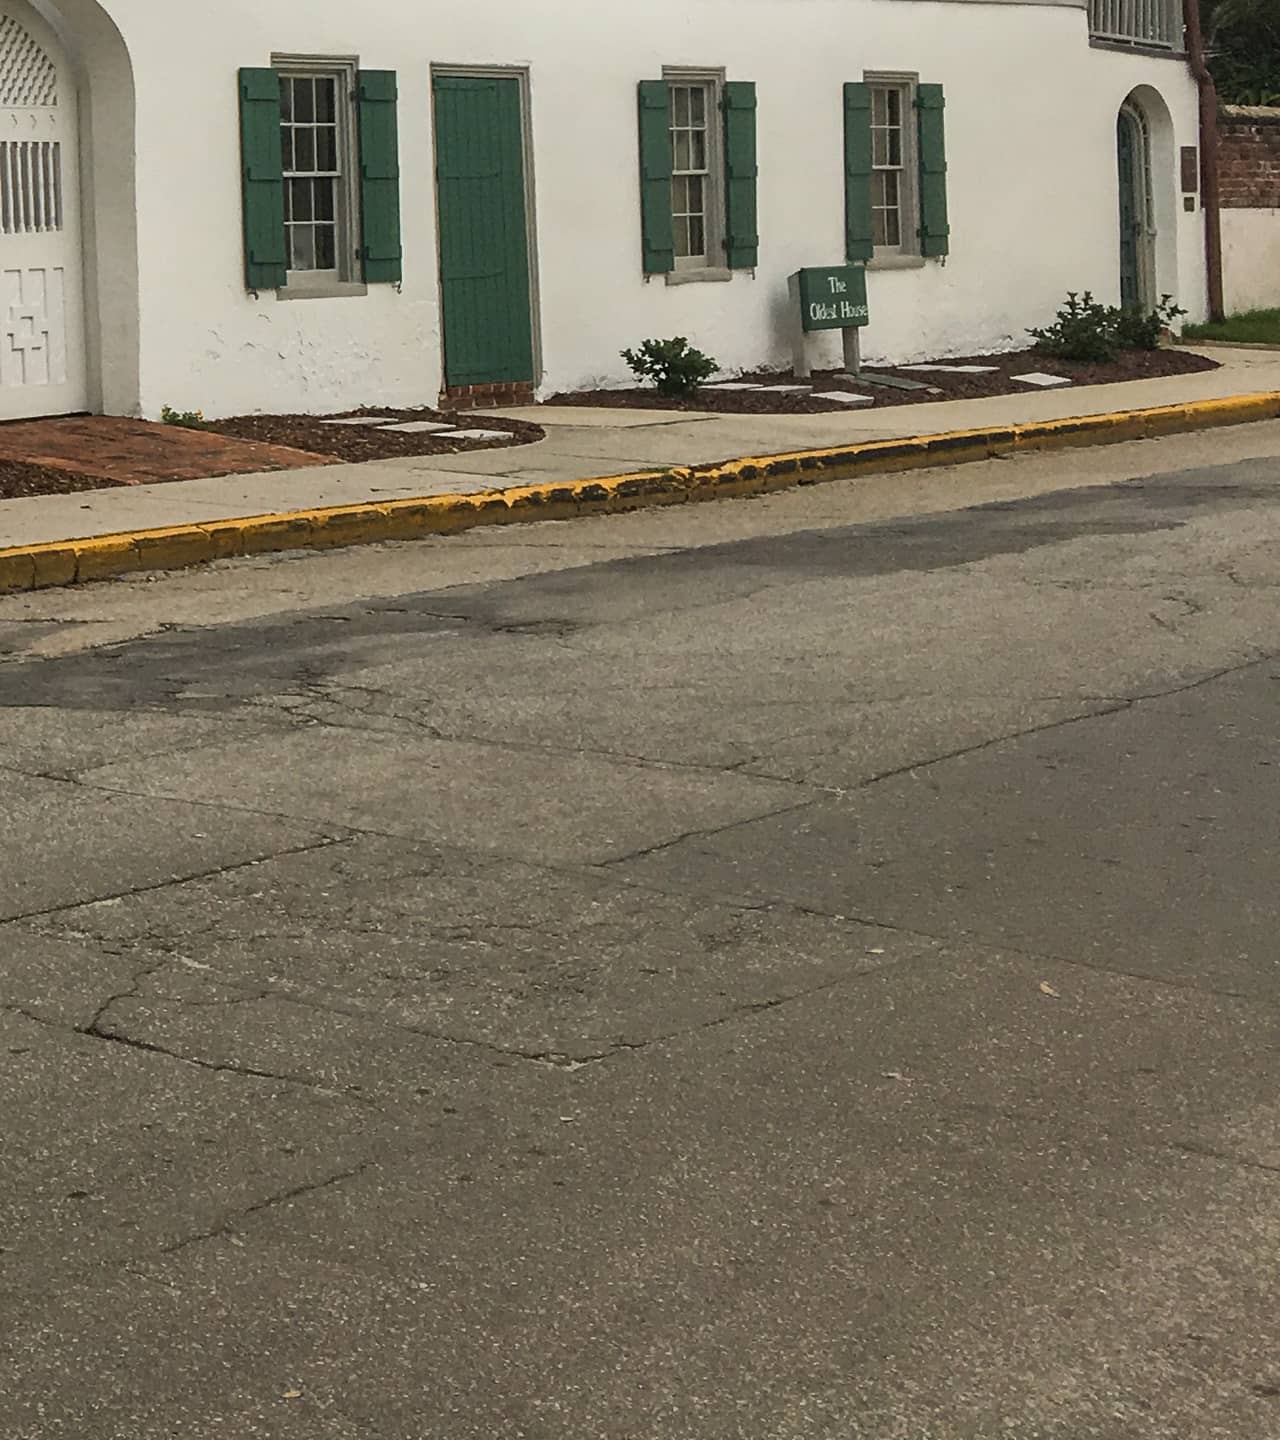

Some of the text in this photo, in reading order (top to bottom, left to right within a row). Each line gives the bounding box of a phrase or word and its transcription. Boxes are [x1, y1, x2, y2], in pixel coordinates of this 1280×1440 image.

[827, 276, 848, 293] The
[809, 301, 868, 321] Oldest House
